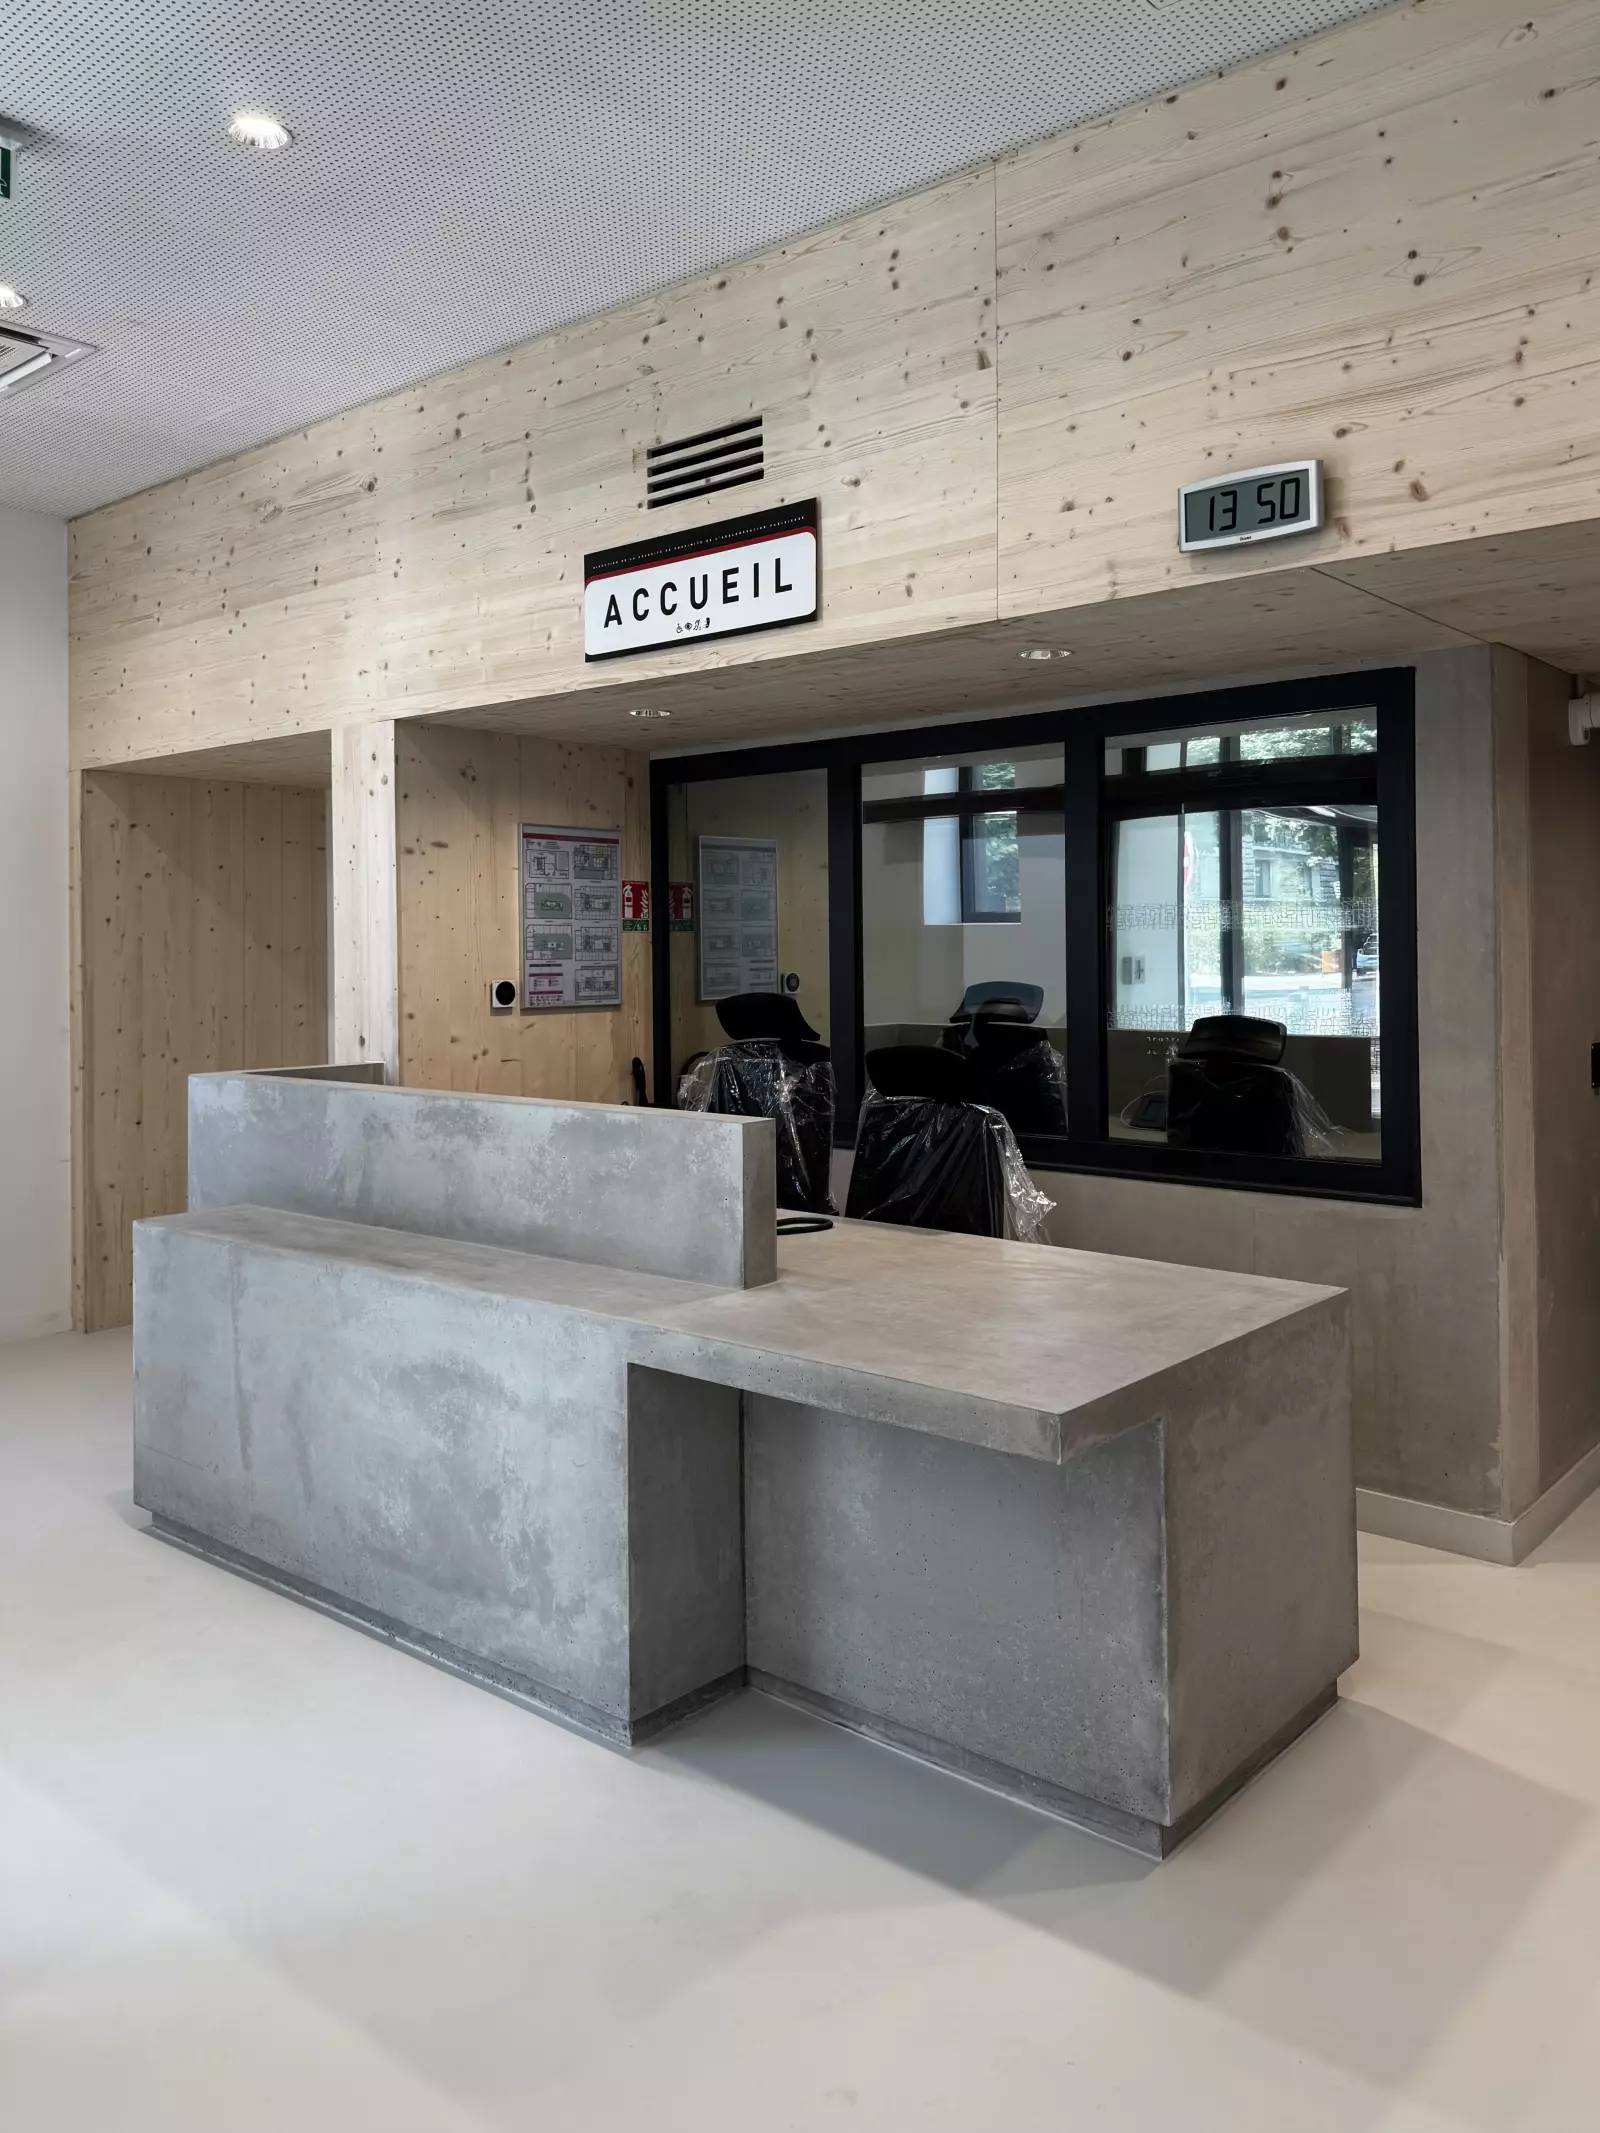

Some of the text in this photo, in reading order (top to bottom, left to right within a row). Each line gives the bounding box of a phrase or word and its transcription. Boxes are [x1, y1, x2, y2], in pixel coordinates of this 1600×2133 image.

[1208, 477, 1301, 532] 13 50
[603, 557, 793, 629] ACCUEIL
